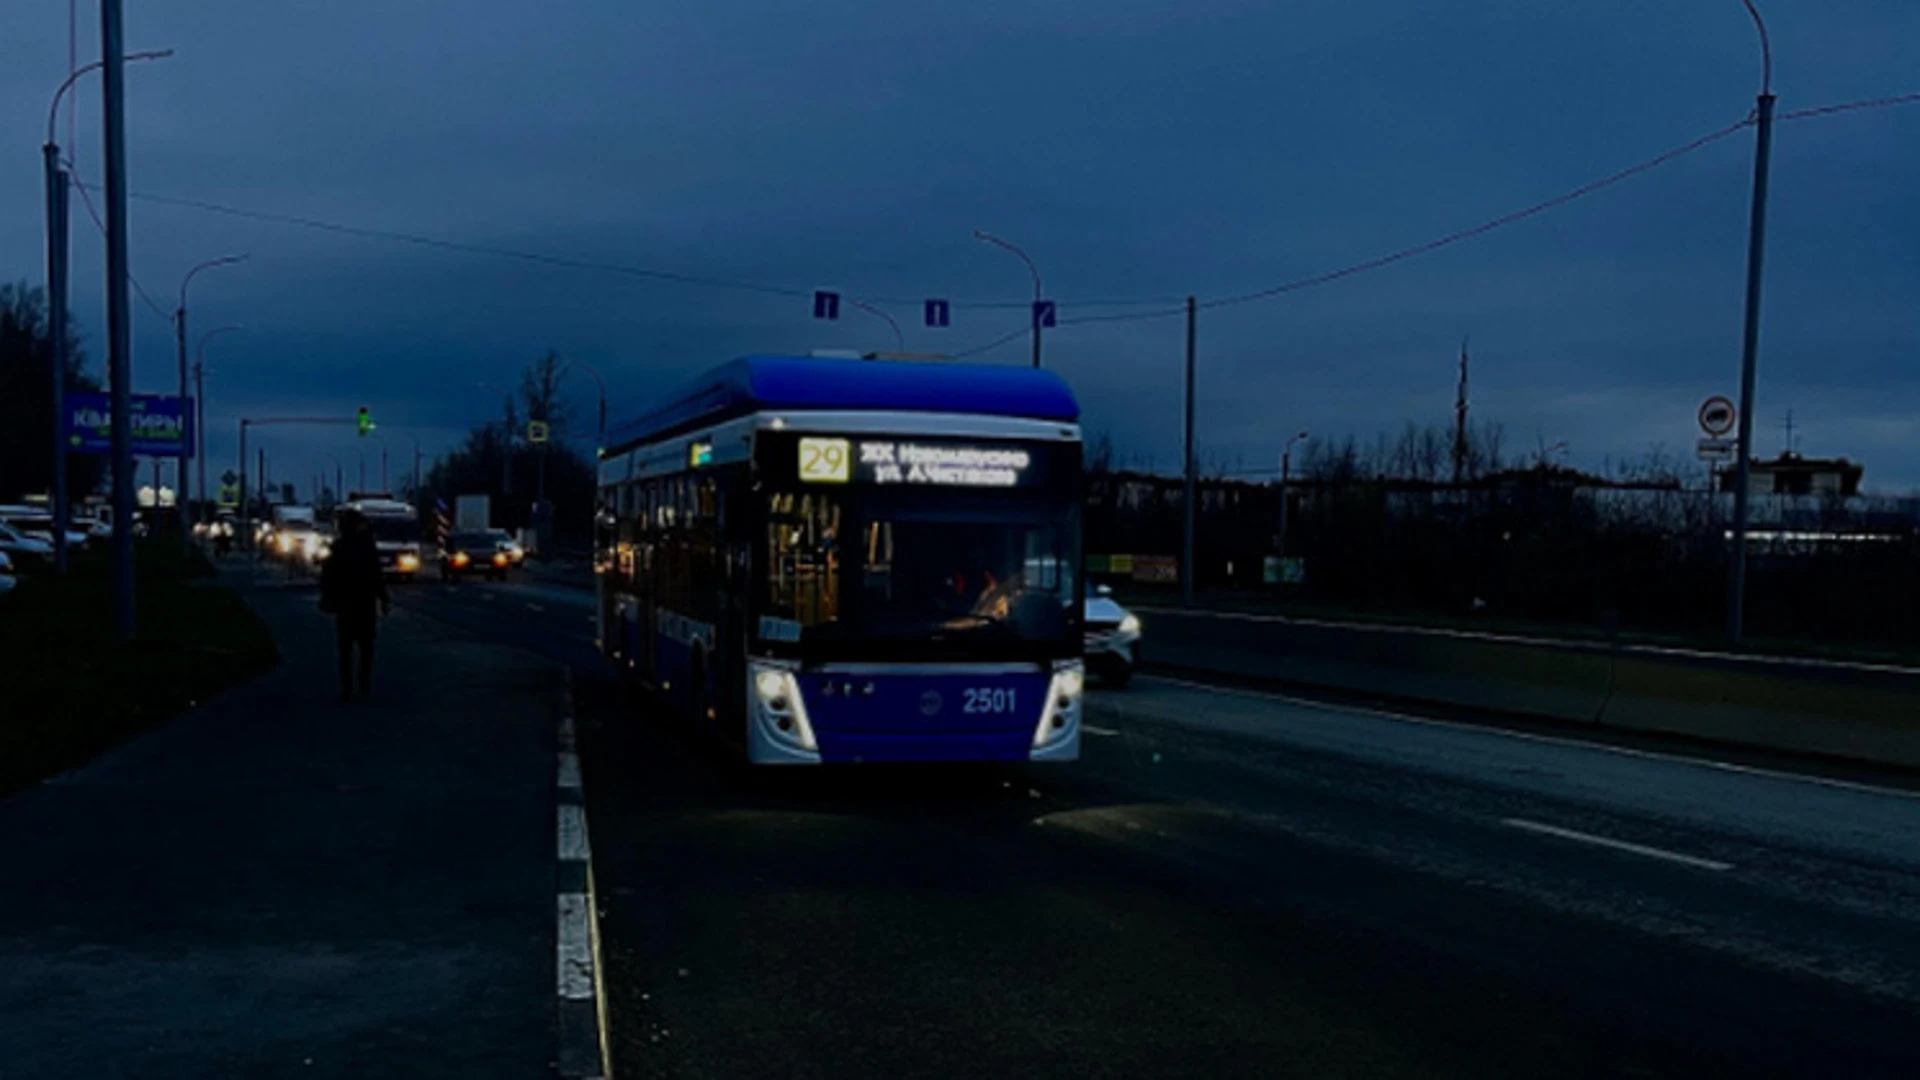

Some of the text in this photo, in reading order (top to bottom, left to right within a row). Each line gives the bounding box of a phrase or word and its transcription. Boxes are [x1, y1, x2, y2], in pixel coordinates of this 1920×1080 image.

[73, 408, 184, 432] КВАТИРЫ
[802, 445, 844, 475] 29
[860, 443, 894, 462] ЖК
[963, 687, 1016, 713] 2501
